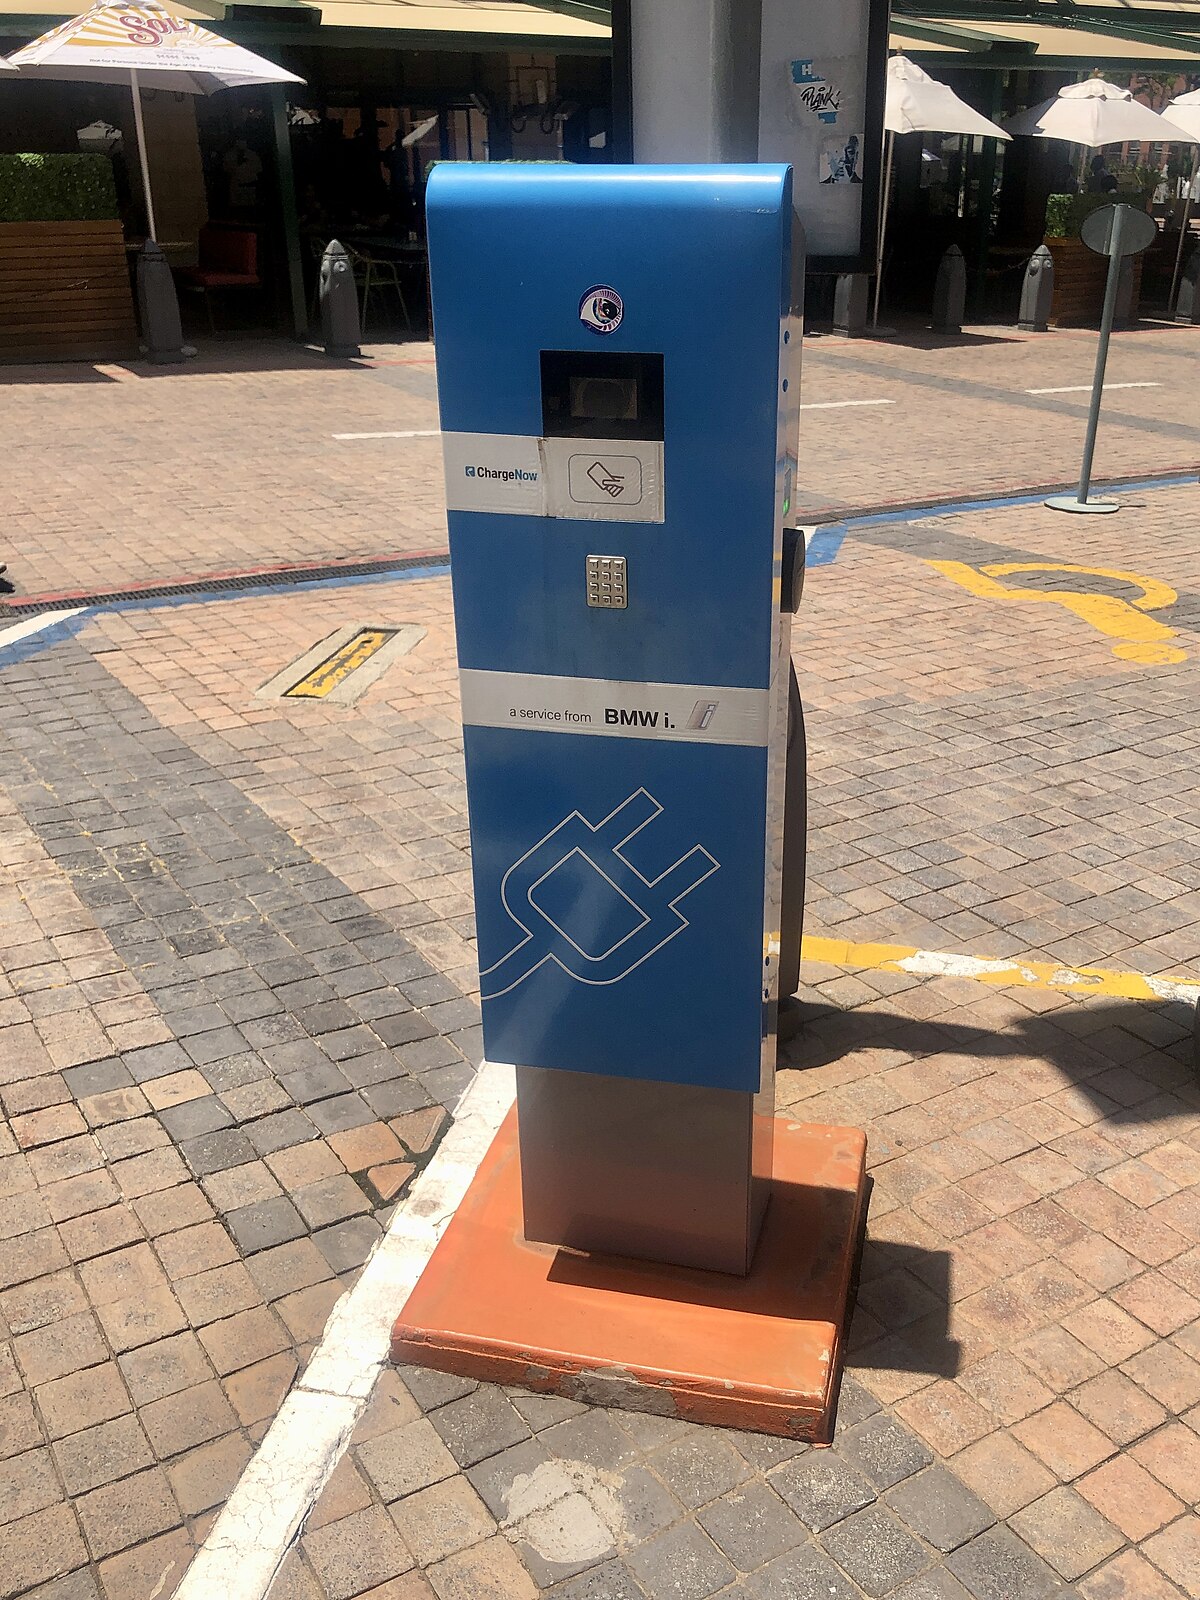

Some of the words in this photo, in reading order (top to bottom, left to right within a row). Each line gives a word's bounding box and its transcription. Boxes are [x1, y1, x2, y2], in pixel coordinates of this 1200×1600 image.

[477, 467, 538, 481] ChargeNow
[509, 708, 516, 717] a
[519, 708, 561, 721] service
[564, 710, 592, 723] from
[604, 708, 659, 728] BMW
[664, 712, 675, 729] i.
